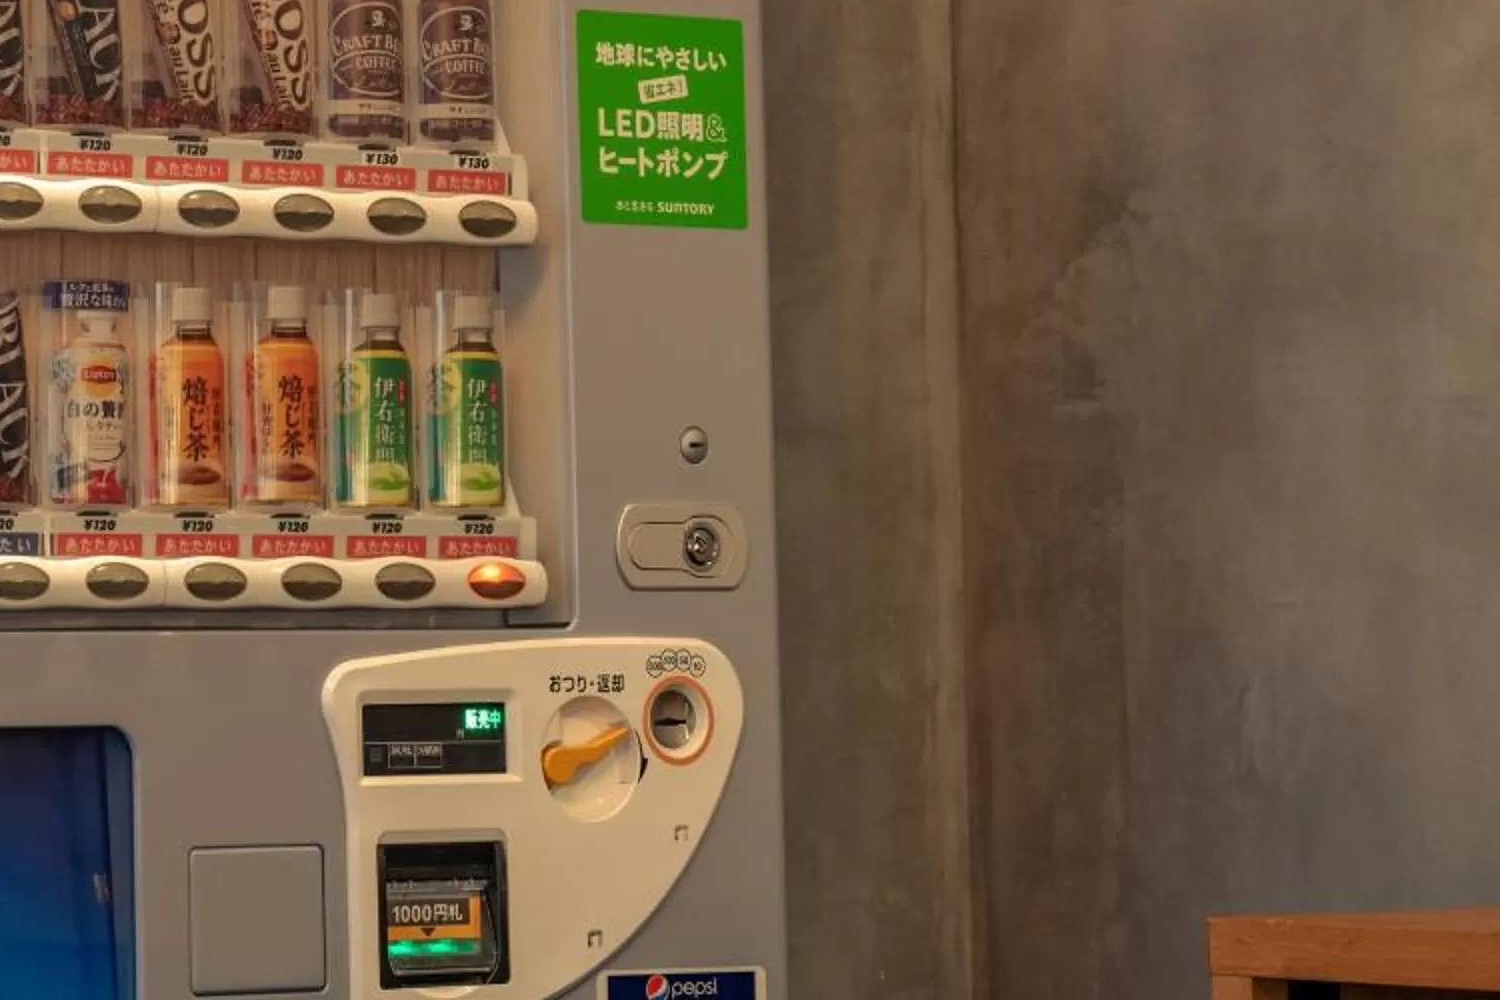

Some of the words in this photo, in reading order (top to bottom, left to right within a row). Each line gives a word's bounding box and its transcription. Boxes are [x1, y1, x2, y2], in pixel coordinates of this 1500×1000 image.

[334, 34, 384, 58] CRAFT
[595, 41, 727, 72] 地球にやさしい
[597, 107, 727, 142] LED照明&
[80, 138, 112, 151] ¥120
[177, 144, 208, 156] ¥120
[272, 149, 304, 161] ¥120
[366, 153, 399, 165] ¥130
[54, 156, 125, 174] あたたかい
[153, 160, 225, 179] あたたかい
[458, 157, 490, 169] ¥130
[599, 147, 729, 181] ヒートポンプ
[249, 165, 318, 183] あたたかい
[343, 168, 409, 186] あたたかい
[435, 174, 499, 191] あたたかい
[657, 202, 716, 216] SUNTORY
[83, 519, 116, 532] ¥120
[182, 520, 214, 532] ¥120
[277, 521, 309, 533] ¥120
[371, 522, 403, 534] ¥120
[464, 523, 495, 535] ¥120
[65, 538, 136, 553] あたたかい
[163, 538, 231, 553] あたたかい
[259, 539, 327, 554] あたたかい
[353, 540, 420, 555] あたたかい
[446, 541, 511, 556] あたたかい
[549, 674, 625, 693] おつり・返却
[391, 904, 464, 923] 1000円札
[669, 977, 718, 1000] pepsi
